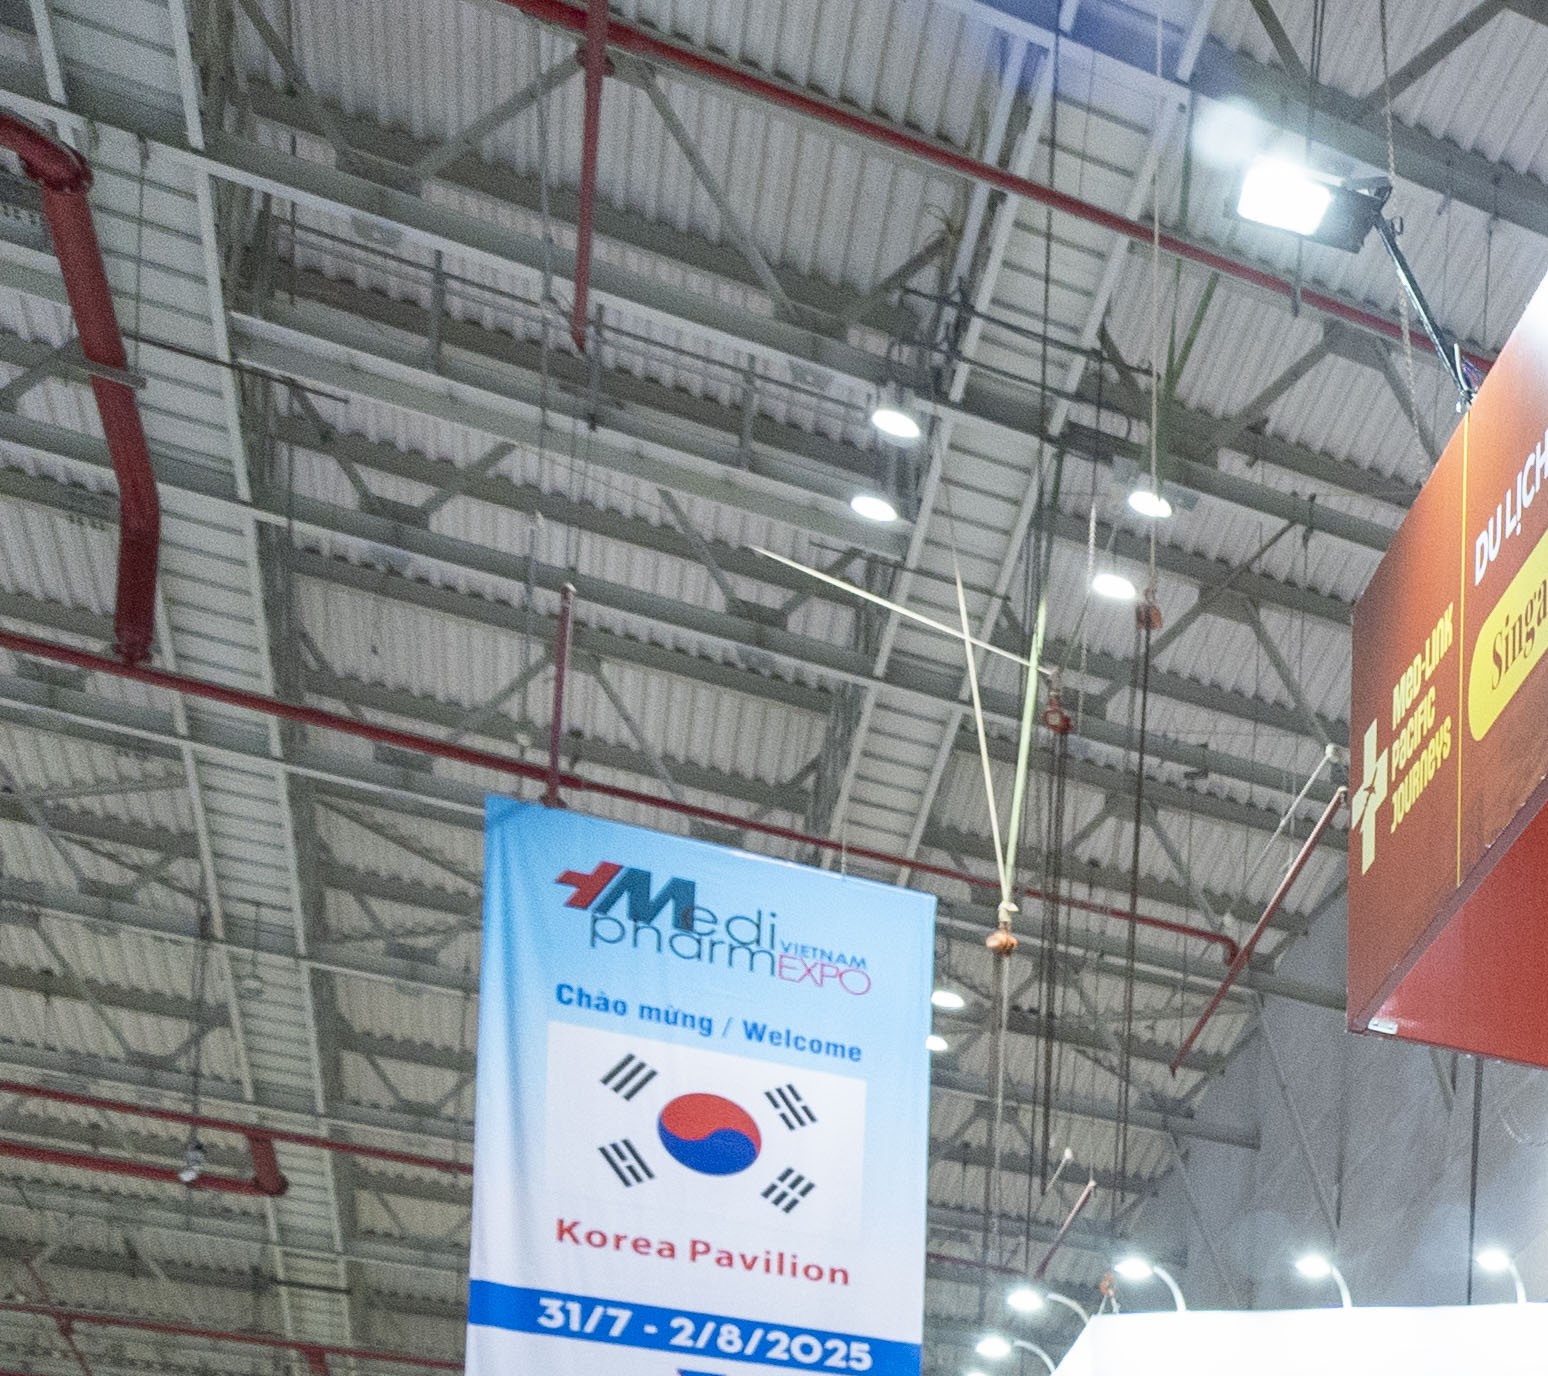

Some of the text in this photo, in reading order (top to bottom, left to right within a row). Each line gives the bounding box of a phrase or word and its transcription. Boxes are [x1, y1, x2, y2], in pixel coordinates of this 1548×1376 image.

[1475, 517, 1502, 585] DU
[590, 869, 777, 952] Medi
[590, 911, 776, 977] pharm
[778, 952, 870, 995] EXPO
[781, 940, 867, 969] VIETNAM
[556, 983, 627, 1017] Chào
[639, 1002, 712, 1037] mừng
[743, 1021, 863, 1062] Welcome
[556, 1219, 850, 1286] Korea Pavilion
[537, 1298, 633, 1338] 31/7
[669, 1315, 872, 1371] 2/8/2025
